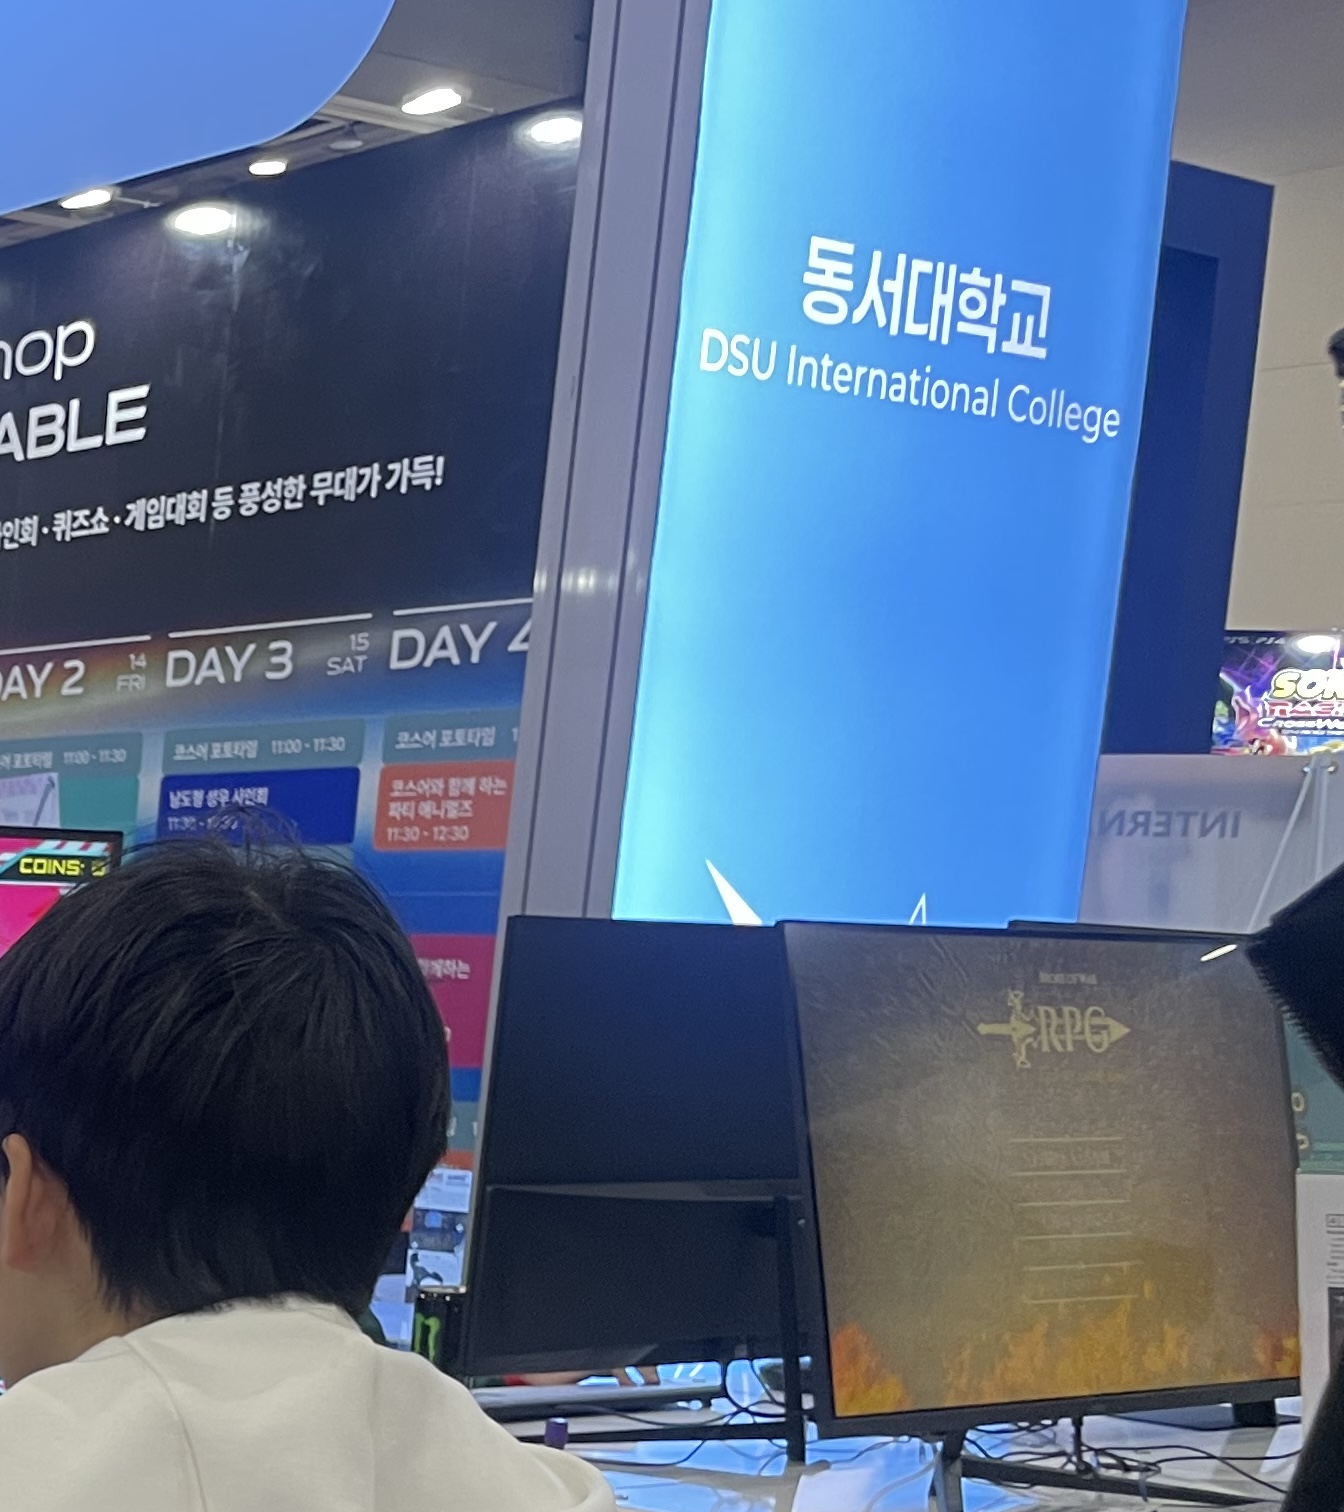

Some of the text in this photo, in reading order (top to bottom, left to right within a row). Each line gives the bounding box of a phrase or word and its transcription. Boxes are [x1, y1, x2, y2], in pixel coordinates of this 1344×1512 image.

[801, 234, 1052, 361] 동서대학교
[699, 327, 1121, 445] DSU International College
[52, 505, 110, 542] 퀴즈쇼
[124, 487, 209, 532] 게임대회
[211, 485, 235, 520] 등
[238, 473, 308, 518] 풍성한
[310, 461, 382, 506] 무대가
[384, 454, 445, 494] 가득!
[128, 652, 148, 671] 14
[165, 639, 294, 688] DAY 3
[326, 654, 369, 677] SAT
[349, 632, 371, 652] 15
[388, 620, 498, 671] DAY
[60, 659, 86, 696] 2
[116, 674, 147, 692] FRI
[1036, 1005, 1111, 1054] RPG
